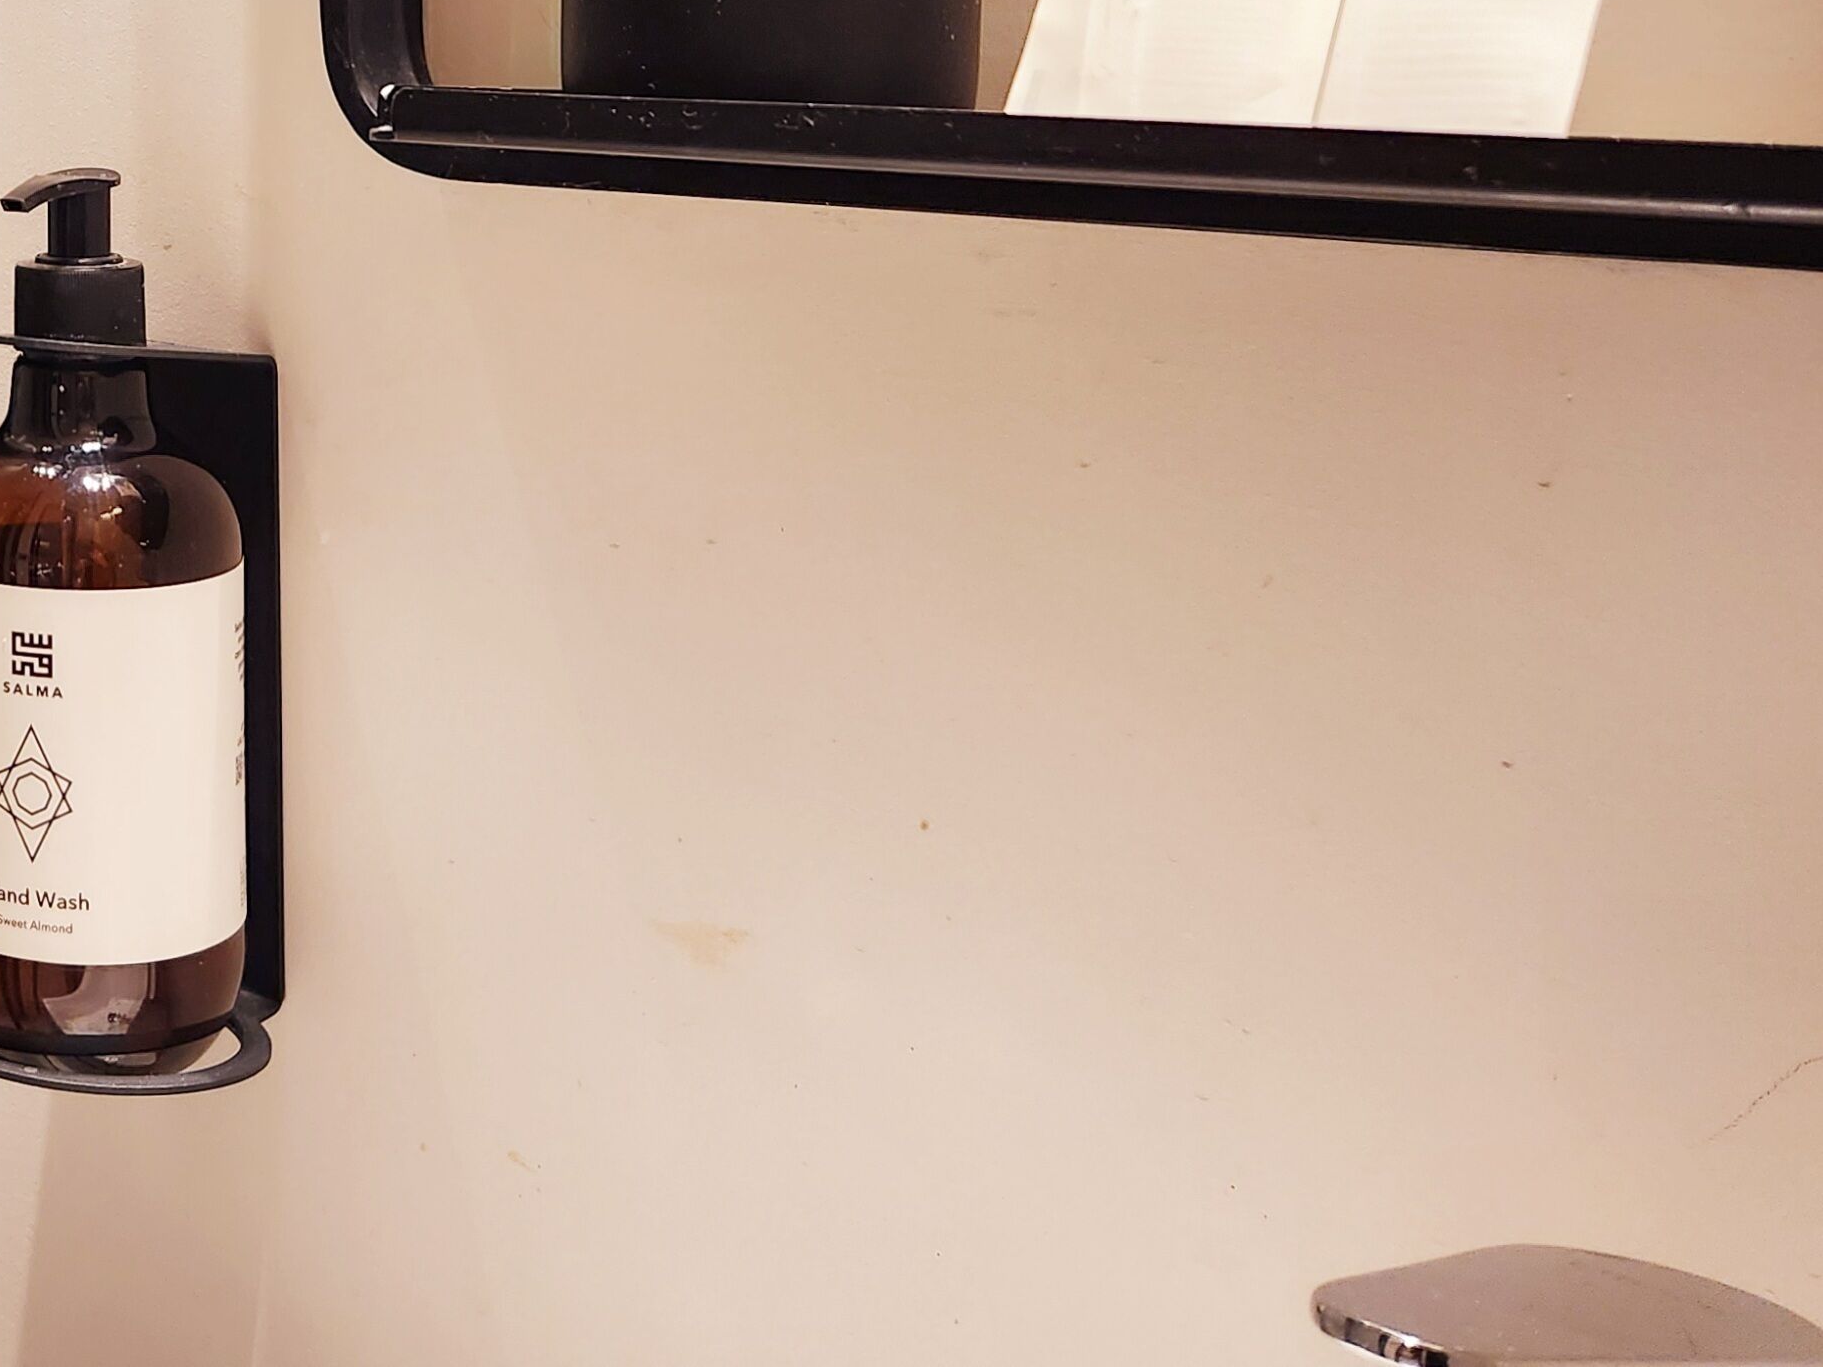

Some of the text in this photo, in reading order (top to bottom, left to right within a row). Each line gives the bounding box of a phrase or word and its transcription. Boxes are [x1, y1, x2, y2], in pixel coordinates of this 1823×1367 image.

[2, 681, 64, 699] SALMA
[35, 889, 91, 912] Wash
[29, 918, 74, 935] Almond
